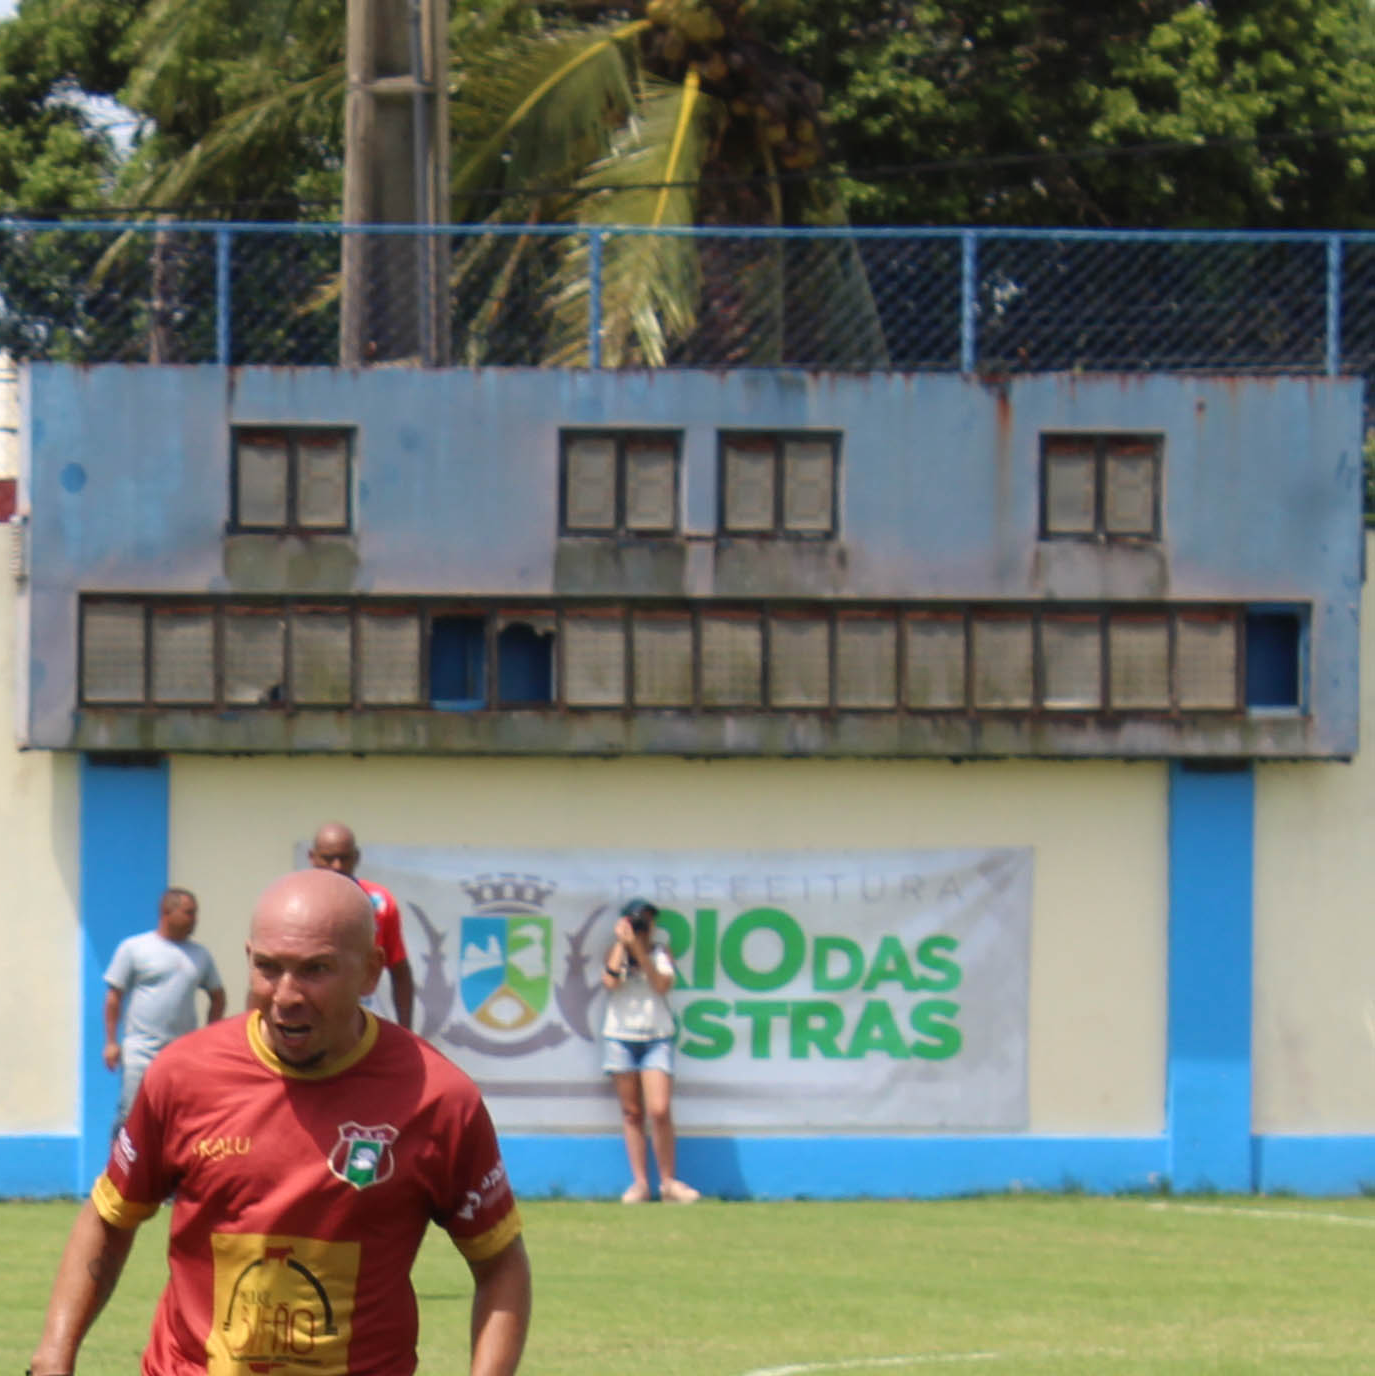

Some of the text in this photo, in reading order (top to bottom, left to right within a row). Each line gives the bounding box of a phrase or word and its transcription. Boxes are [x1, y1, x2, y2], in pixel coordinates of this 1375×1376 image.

[617, 873, 963, 901] PREFEITURA
[811, 934, 963, 993] DAS
[670, 1000, 963, 1060] STRAS
